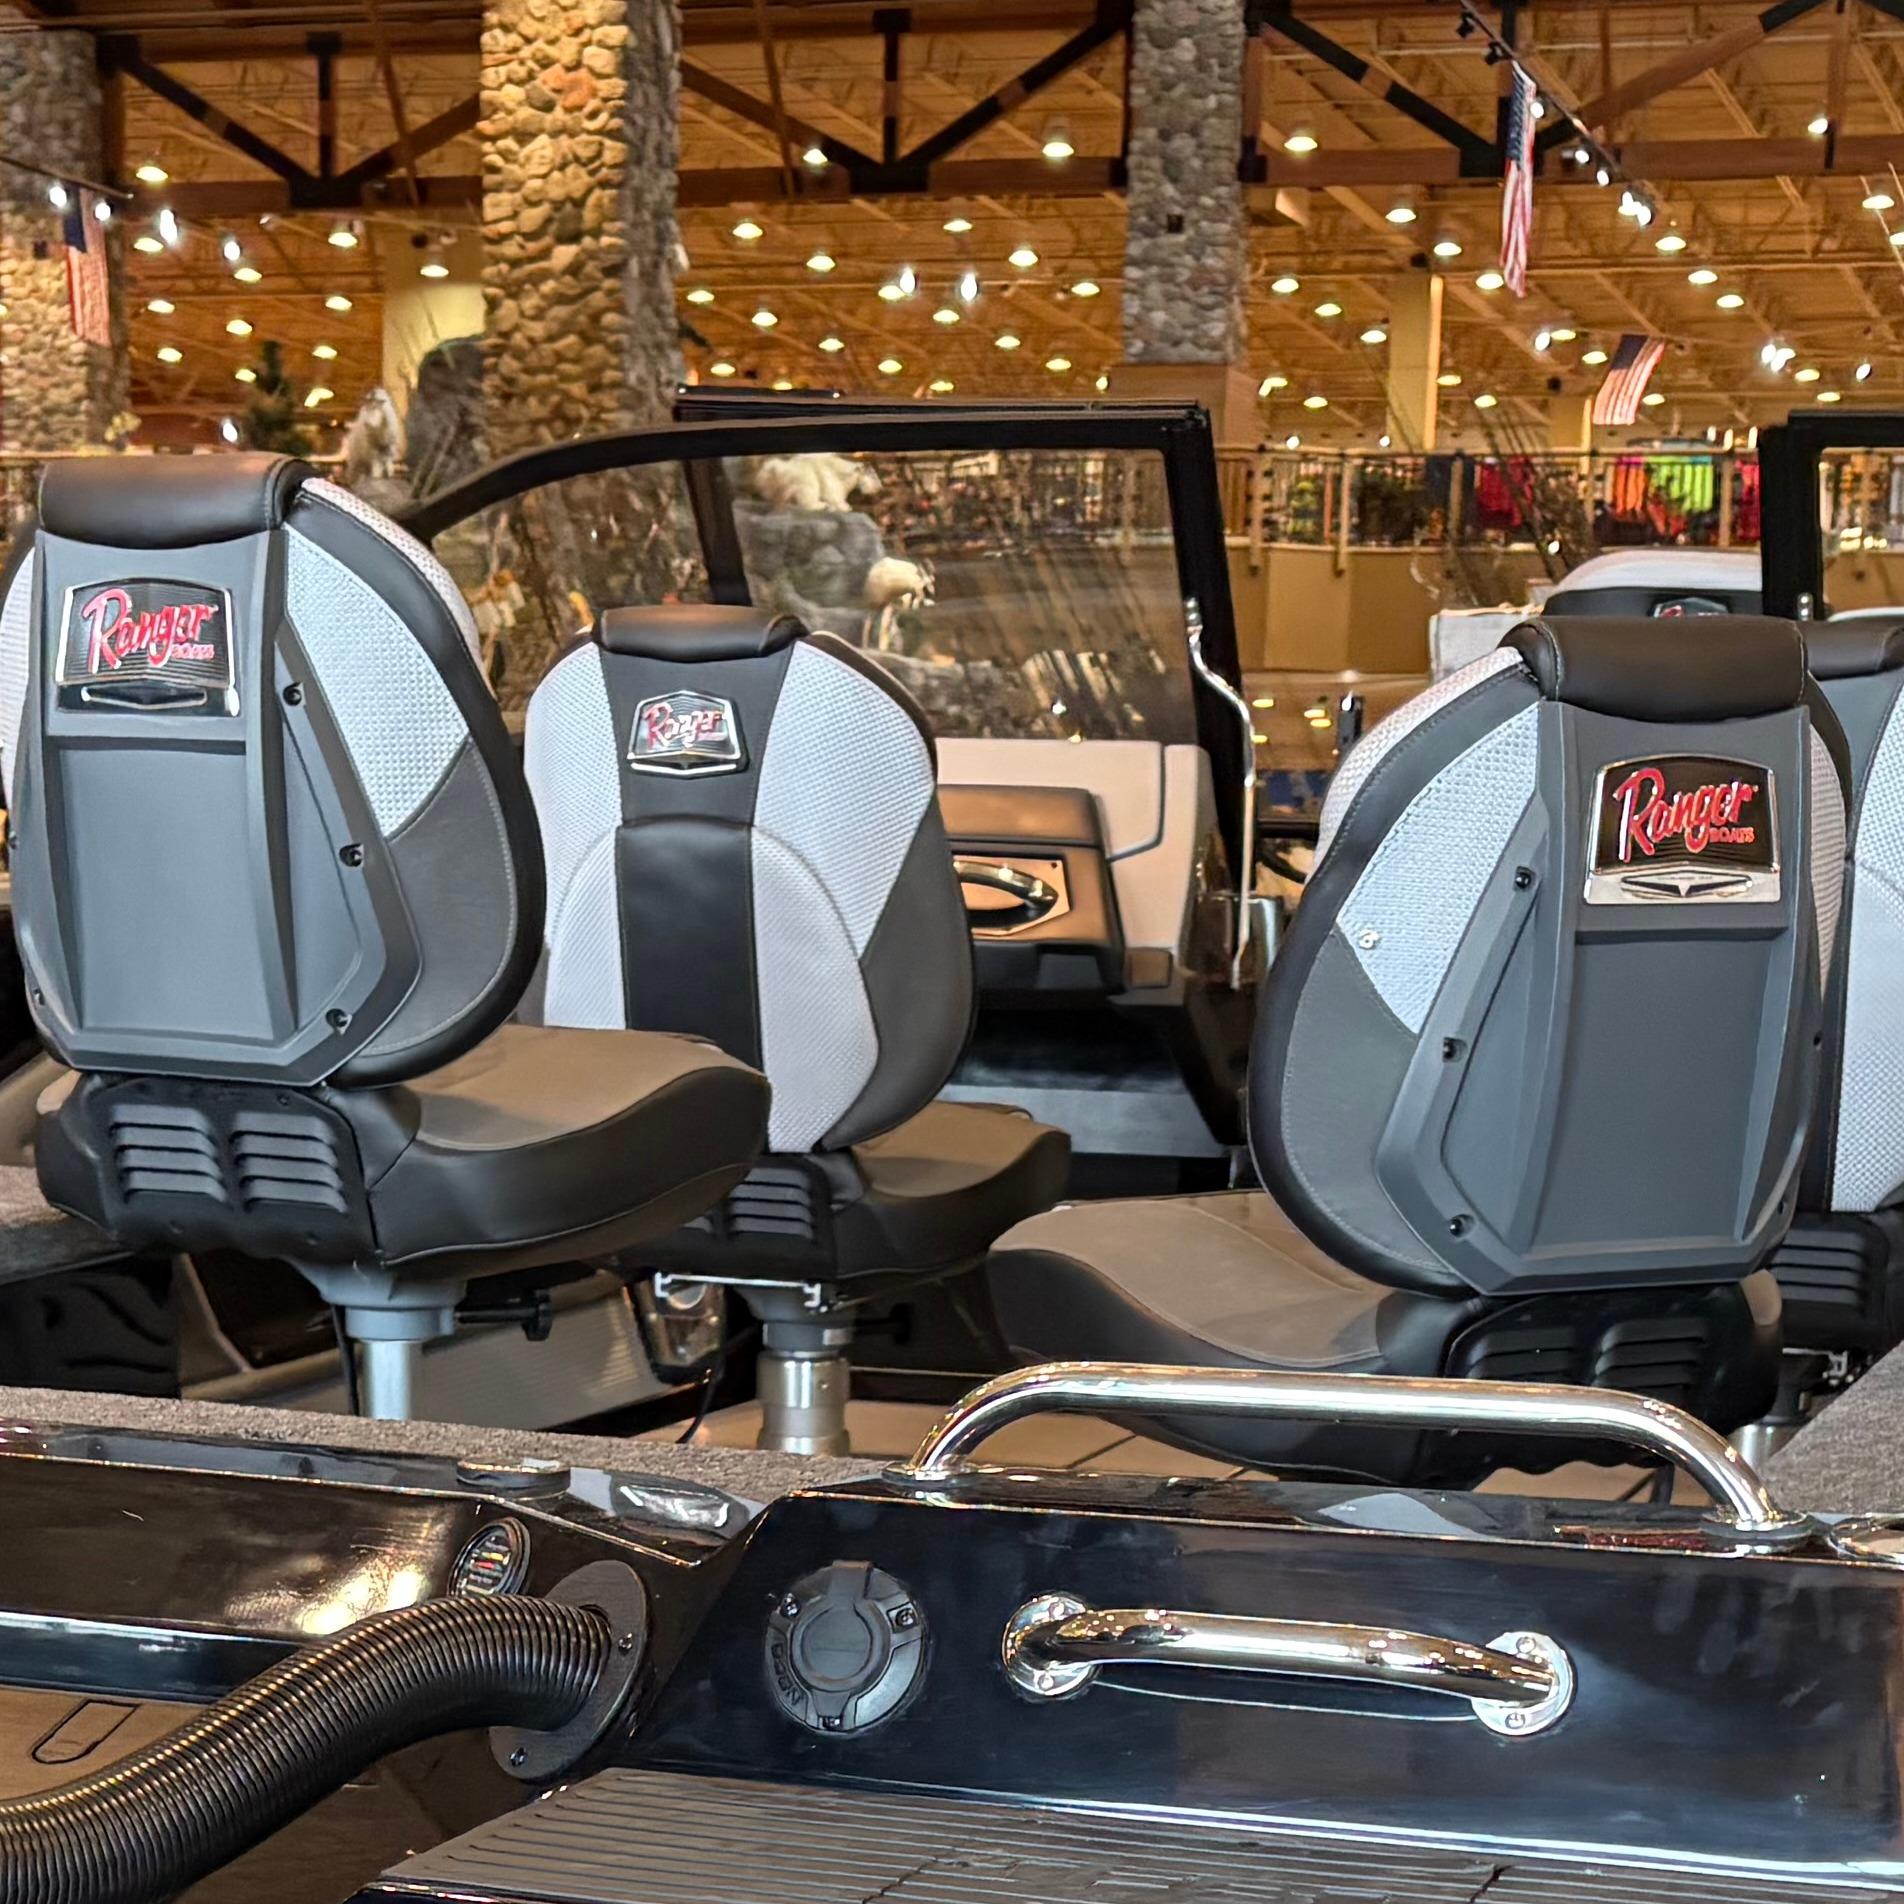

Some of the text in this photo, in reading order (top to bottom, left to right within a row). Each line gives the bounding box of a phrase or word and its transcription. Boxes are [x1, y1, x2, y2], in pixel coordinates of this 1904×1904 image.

[82, 587, 218, 674] Ranger
[643, 702, 725, 752] Ranger
[1613, 767, 1758, 863] Ranger
[1710, 827, 1756, 843] BOATS
